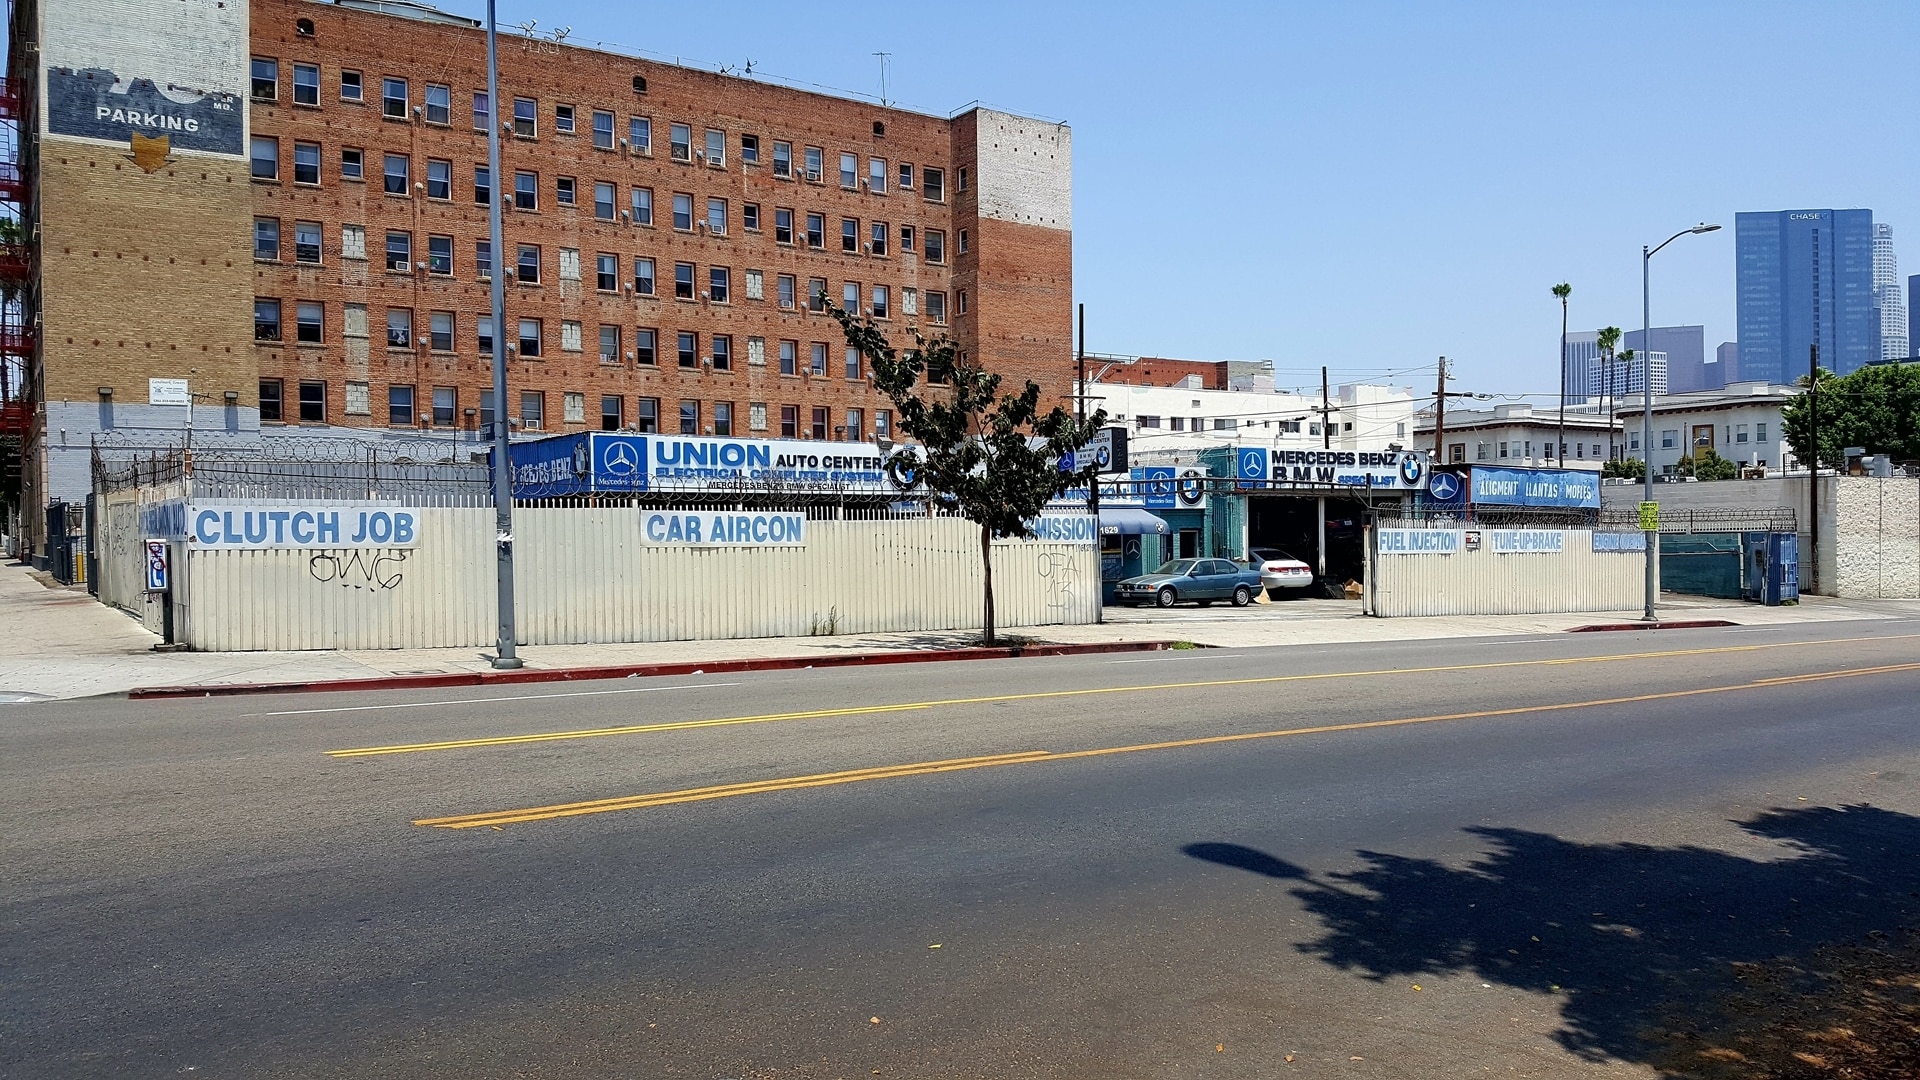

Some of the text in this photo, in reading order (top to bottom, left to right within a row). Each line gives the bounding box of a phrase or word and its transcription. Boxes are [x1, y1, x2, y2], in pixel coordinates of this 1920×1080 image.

[97, 106, 199, 132] PARKING
[656, 441, 882, 470] UNION AUTO CENTER
[1271, 451, 1397, 466] MERCEDES BENZ
[655, 467, 742, 480] ELECTRICAL
[830, 471, 883, 482] SYSTEM
[1337, 475, 1397, 486] SPECALIST
[708, 481, 755, 490] MERCEDES
[807, 483, 849, 491] SPECIALIST
[1480, 480, 1592, 500] ALIGMENT LLANTAS MOFLES
[196, 510, 340, 544] CLUTCH
[351, 511, 414, 543] JOB
[646, 514, 801, 543] CAR AIRCON
[1024, 518, 1096, 541] SMISSION
[1100, 526, 1119, 534] 1629
[1380, 532, 1406, 550] FUEL
[1408, 531, 1457, 550] INJECTION
